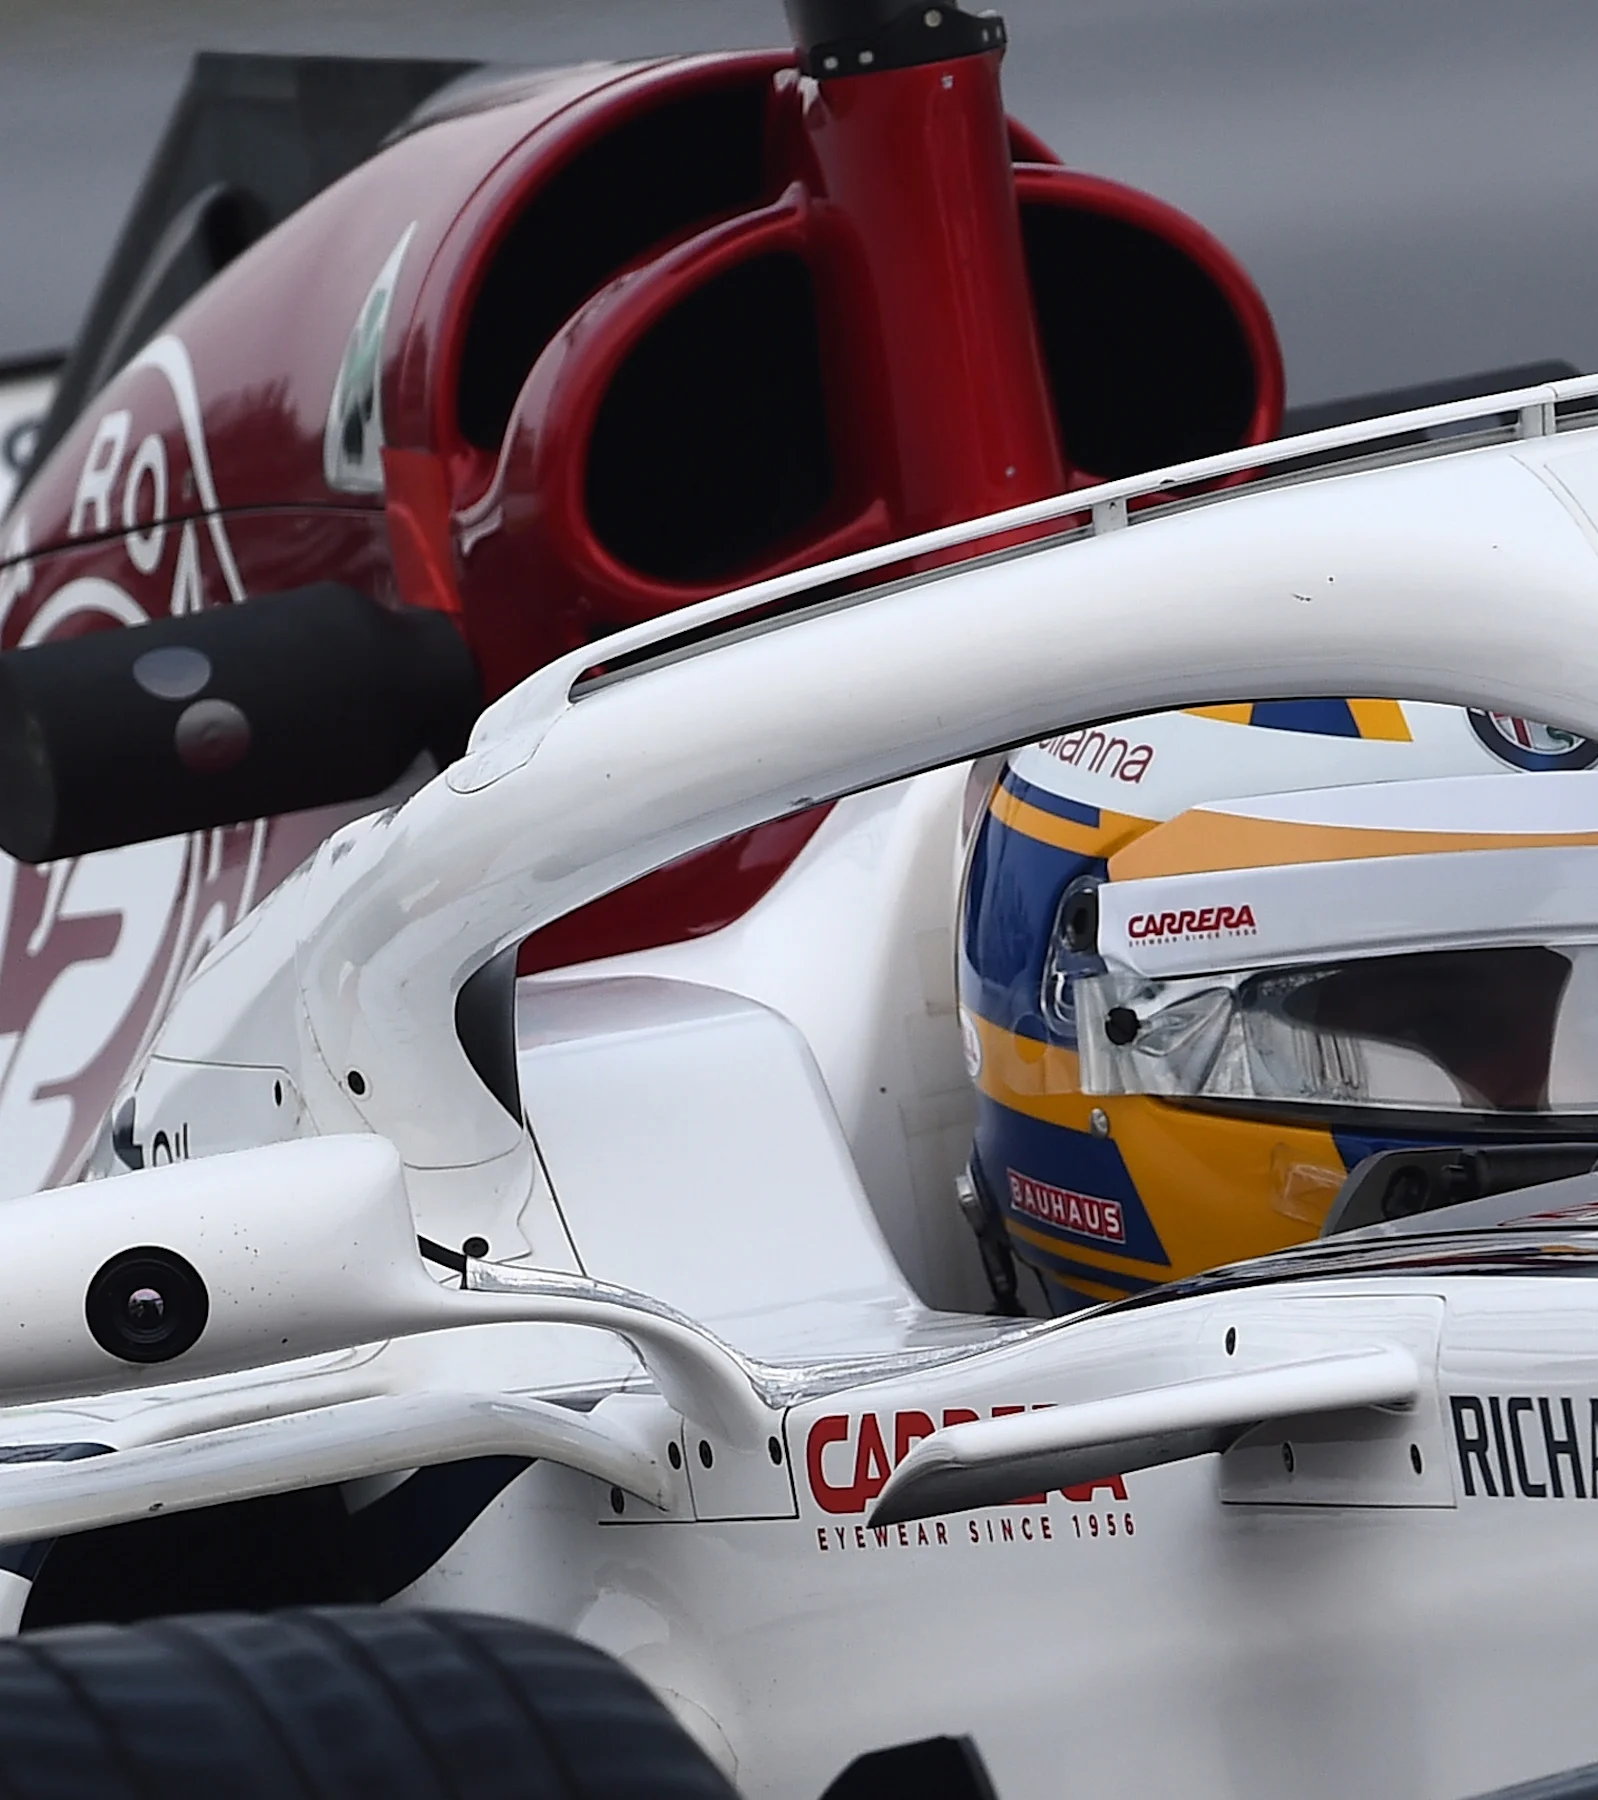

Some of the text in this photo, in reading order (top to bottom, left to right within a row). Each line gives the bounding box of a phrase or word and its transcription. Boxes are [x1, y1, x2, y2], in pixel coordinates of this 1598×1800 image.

[1128, 905, 1256, 938] CARRERA
[1010, 1176, 1120, 1234] BAUHAUS
[816, 1512, 1135, 1551] EYEWEAR SINCE 1956
